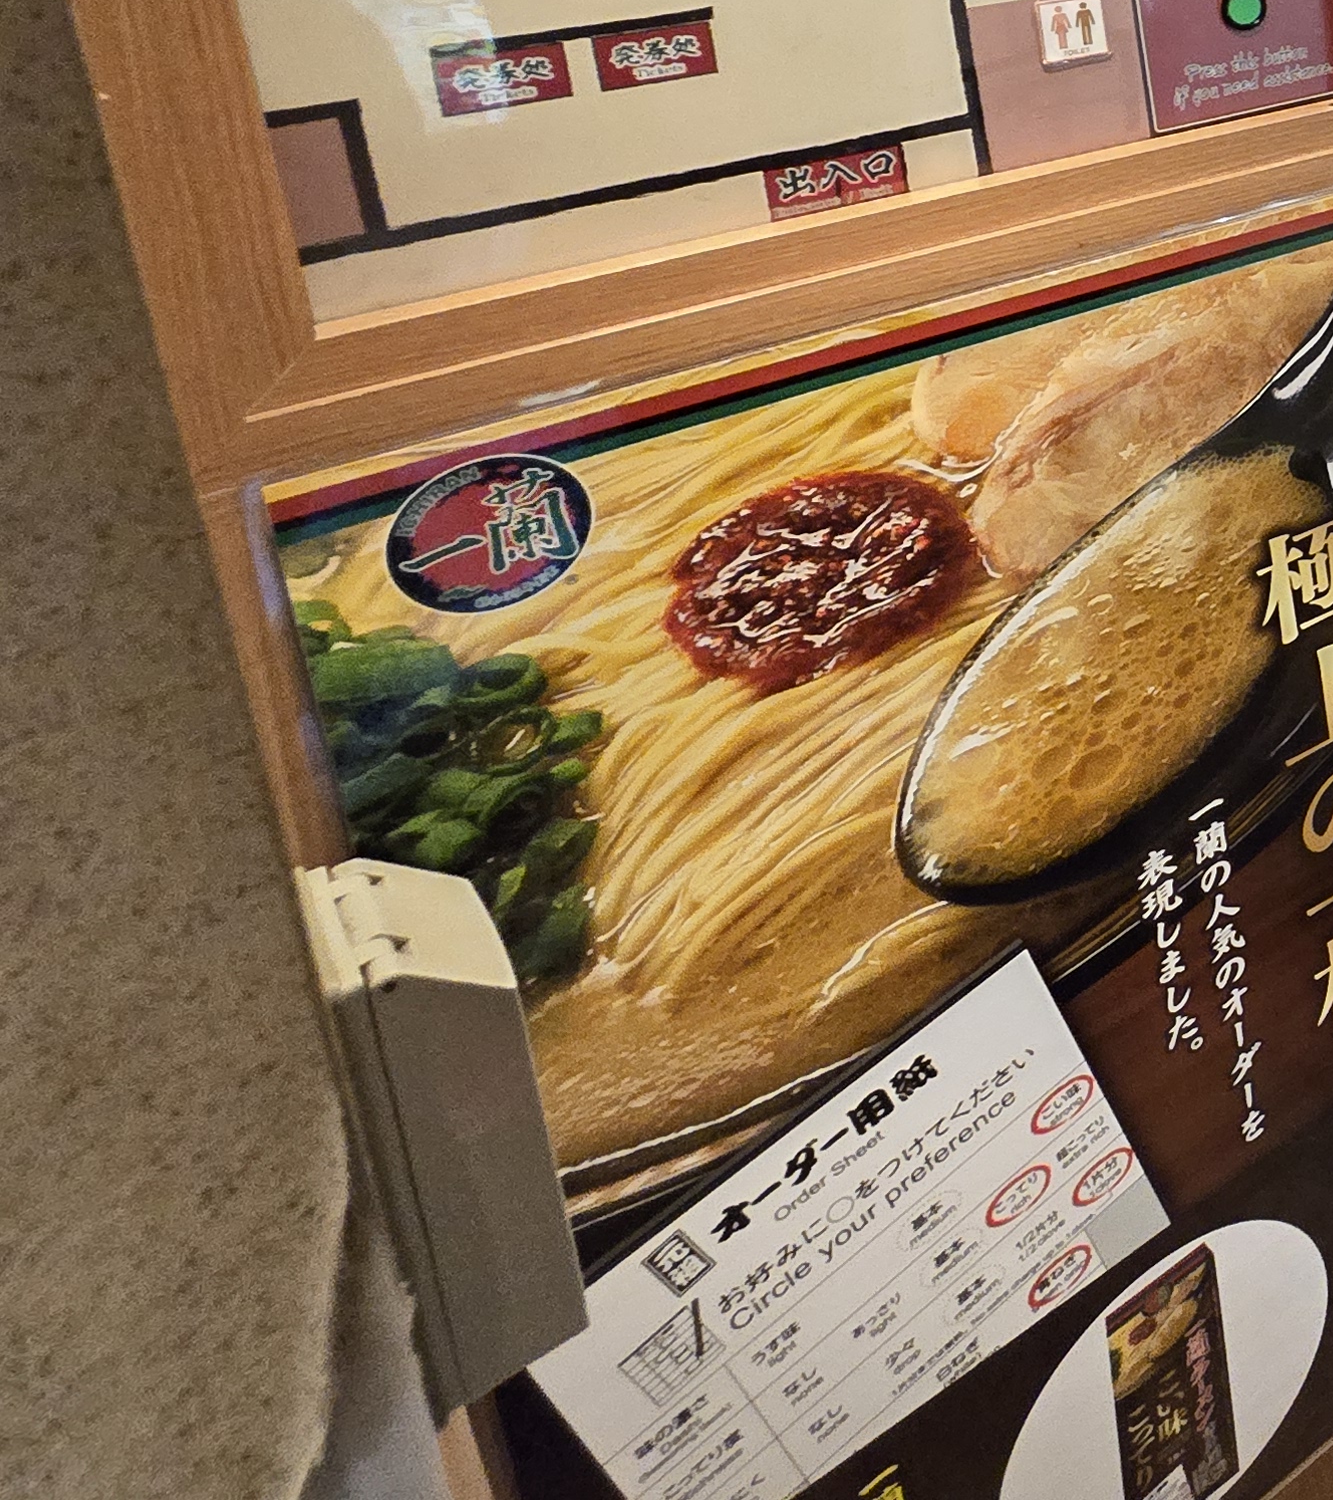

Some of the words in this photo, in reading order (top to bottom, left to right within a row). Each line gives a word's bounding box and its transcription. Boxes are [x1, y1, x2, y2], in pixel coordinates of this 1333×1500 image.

[1185, 63, 1228, 82] Press
[1263, 47, 1308, 66] button
[778, 152, 894, 201] 出入口
[399, 467, 580, 576] 一蘭
[1138, 850, 1204, 1053] 表現しました。
[1187, 796, 1270, 1142] 一蘭の人気のオーダーを
[1041, 1084, 1082, 1120] こい味
[710, 1054, 938, 1244] オーダー用紙
[1090, 1126, 1110, 1144] rich
[774, 1175, 827, 1222] Order
[830, 1131, 885, 1177] Sheet
[992, 1172, 1038, 1214] こってり
[1081, 1156, 1118, 1190] 1片分
[729, 1261, 812, 1330] Circle
[817, 1203, 876, 1264] your
[884, 1092, 1016, 1209] preference
[910, 1200, 943, 1232] 基本
[1010, 1195, 1032, 1214] rich
[909, 1205, 957, 1248] medium
[1015, 1210, 1058, 1250] 1/2片分
[931, 1241, 979, 1286] medium
[933, 1237, 965, 1269] 基本
[954, 1278, 1002, 1321] medium
[955, 1274, 987, 1306] 基本
[851, 1292, 901, 1339] あっさり
[751, 1321, 801, 1367] うす味
[885, 1337, 915, 1370] 少々
[782, 1367, 817, 1398] なし
[791, 1376, 824, 1407] none
[808, 1405, 842, 1435] なし
[817, 1413, 850, 1444] none
